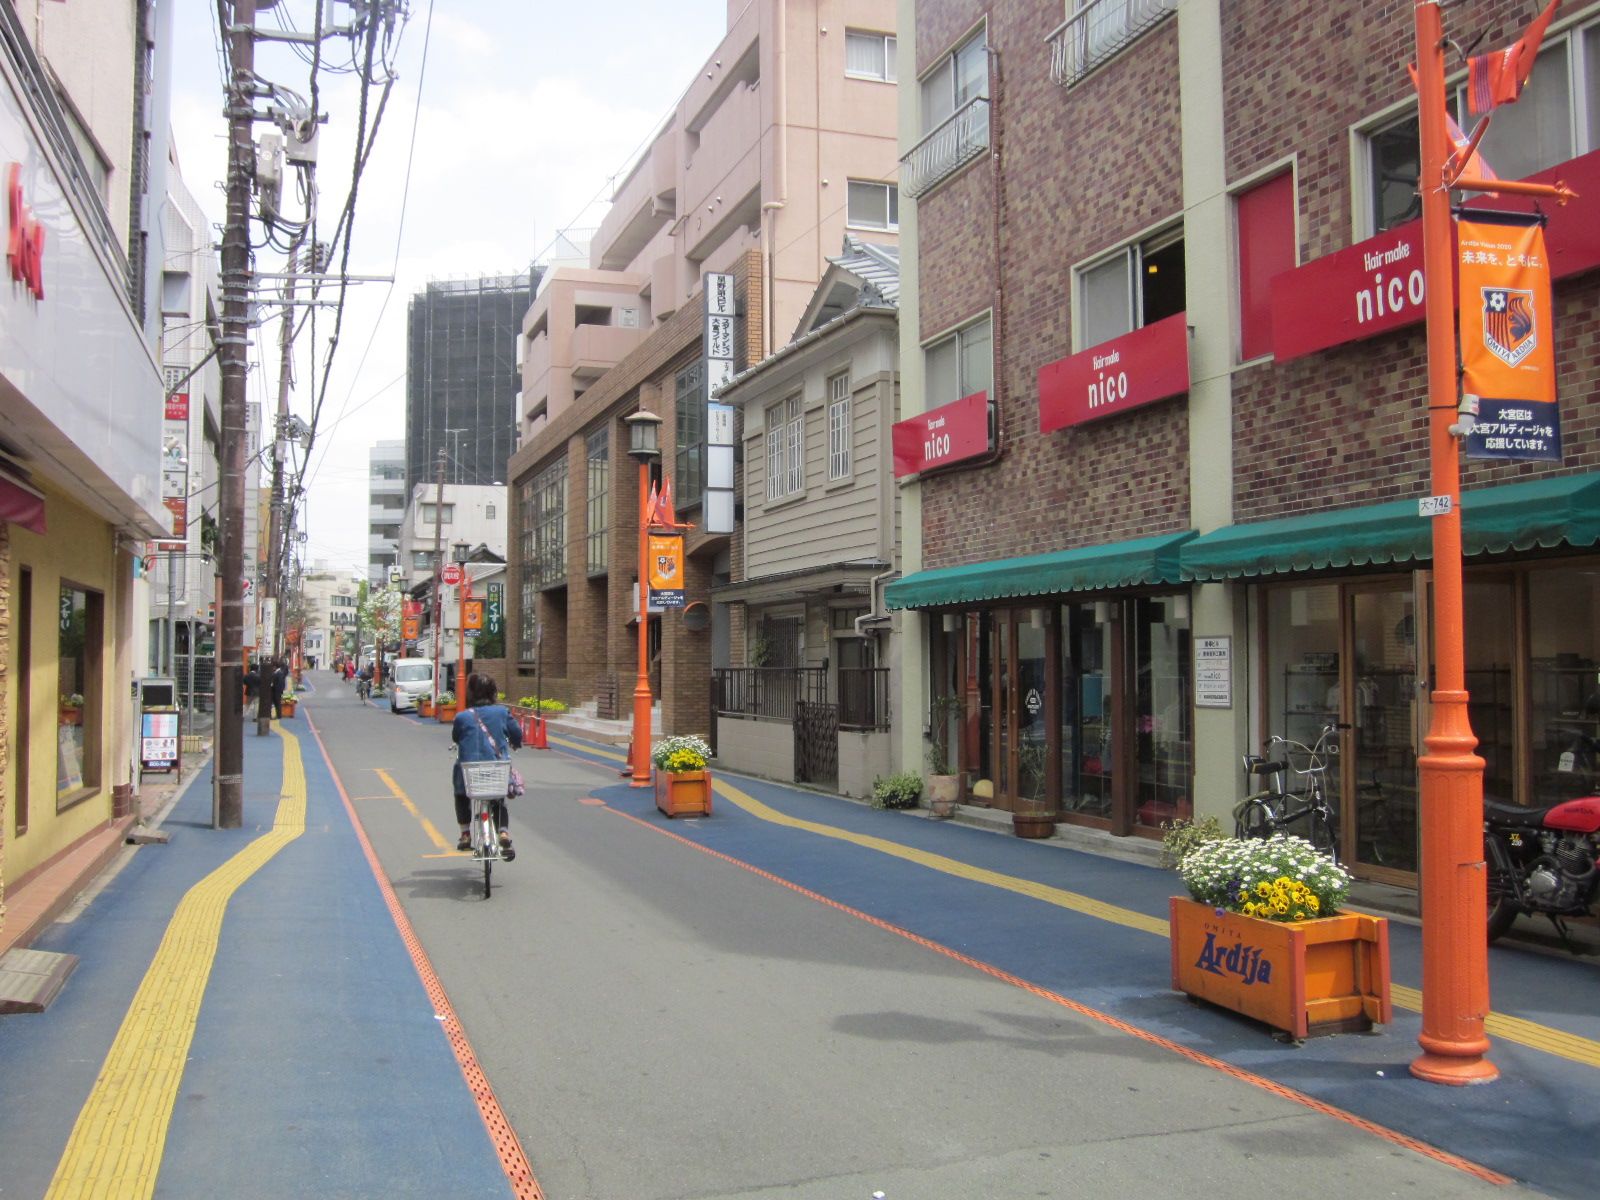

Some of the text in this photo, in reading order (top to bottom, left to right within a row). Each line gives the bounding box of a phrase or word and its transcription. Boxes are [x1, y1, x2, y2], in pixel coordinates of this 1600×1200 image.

[1364, 241, 1410, 273] Hair make
[1462, 250, 1543, 268] 未来を、ともに。
[1356, 269, 1424, 324] nico
[1093, 349, 1120, 371] Hair make
[1488, 337, 1511, 361] OMIYA
[1088, 371, 1128, 409] nico
[1498, 408, 1532, 421] 大宮区は
[1470, 422, 1553, 437] 大宮アルディージャを
[924, 433, 950, 462] nico
[1485, 437, 1548, 451] 応援しています。
[489, 603, 500, 634] くすり
[1195, 931, 1272, 985] Ardija
